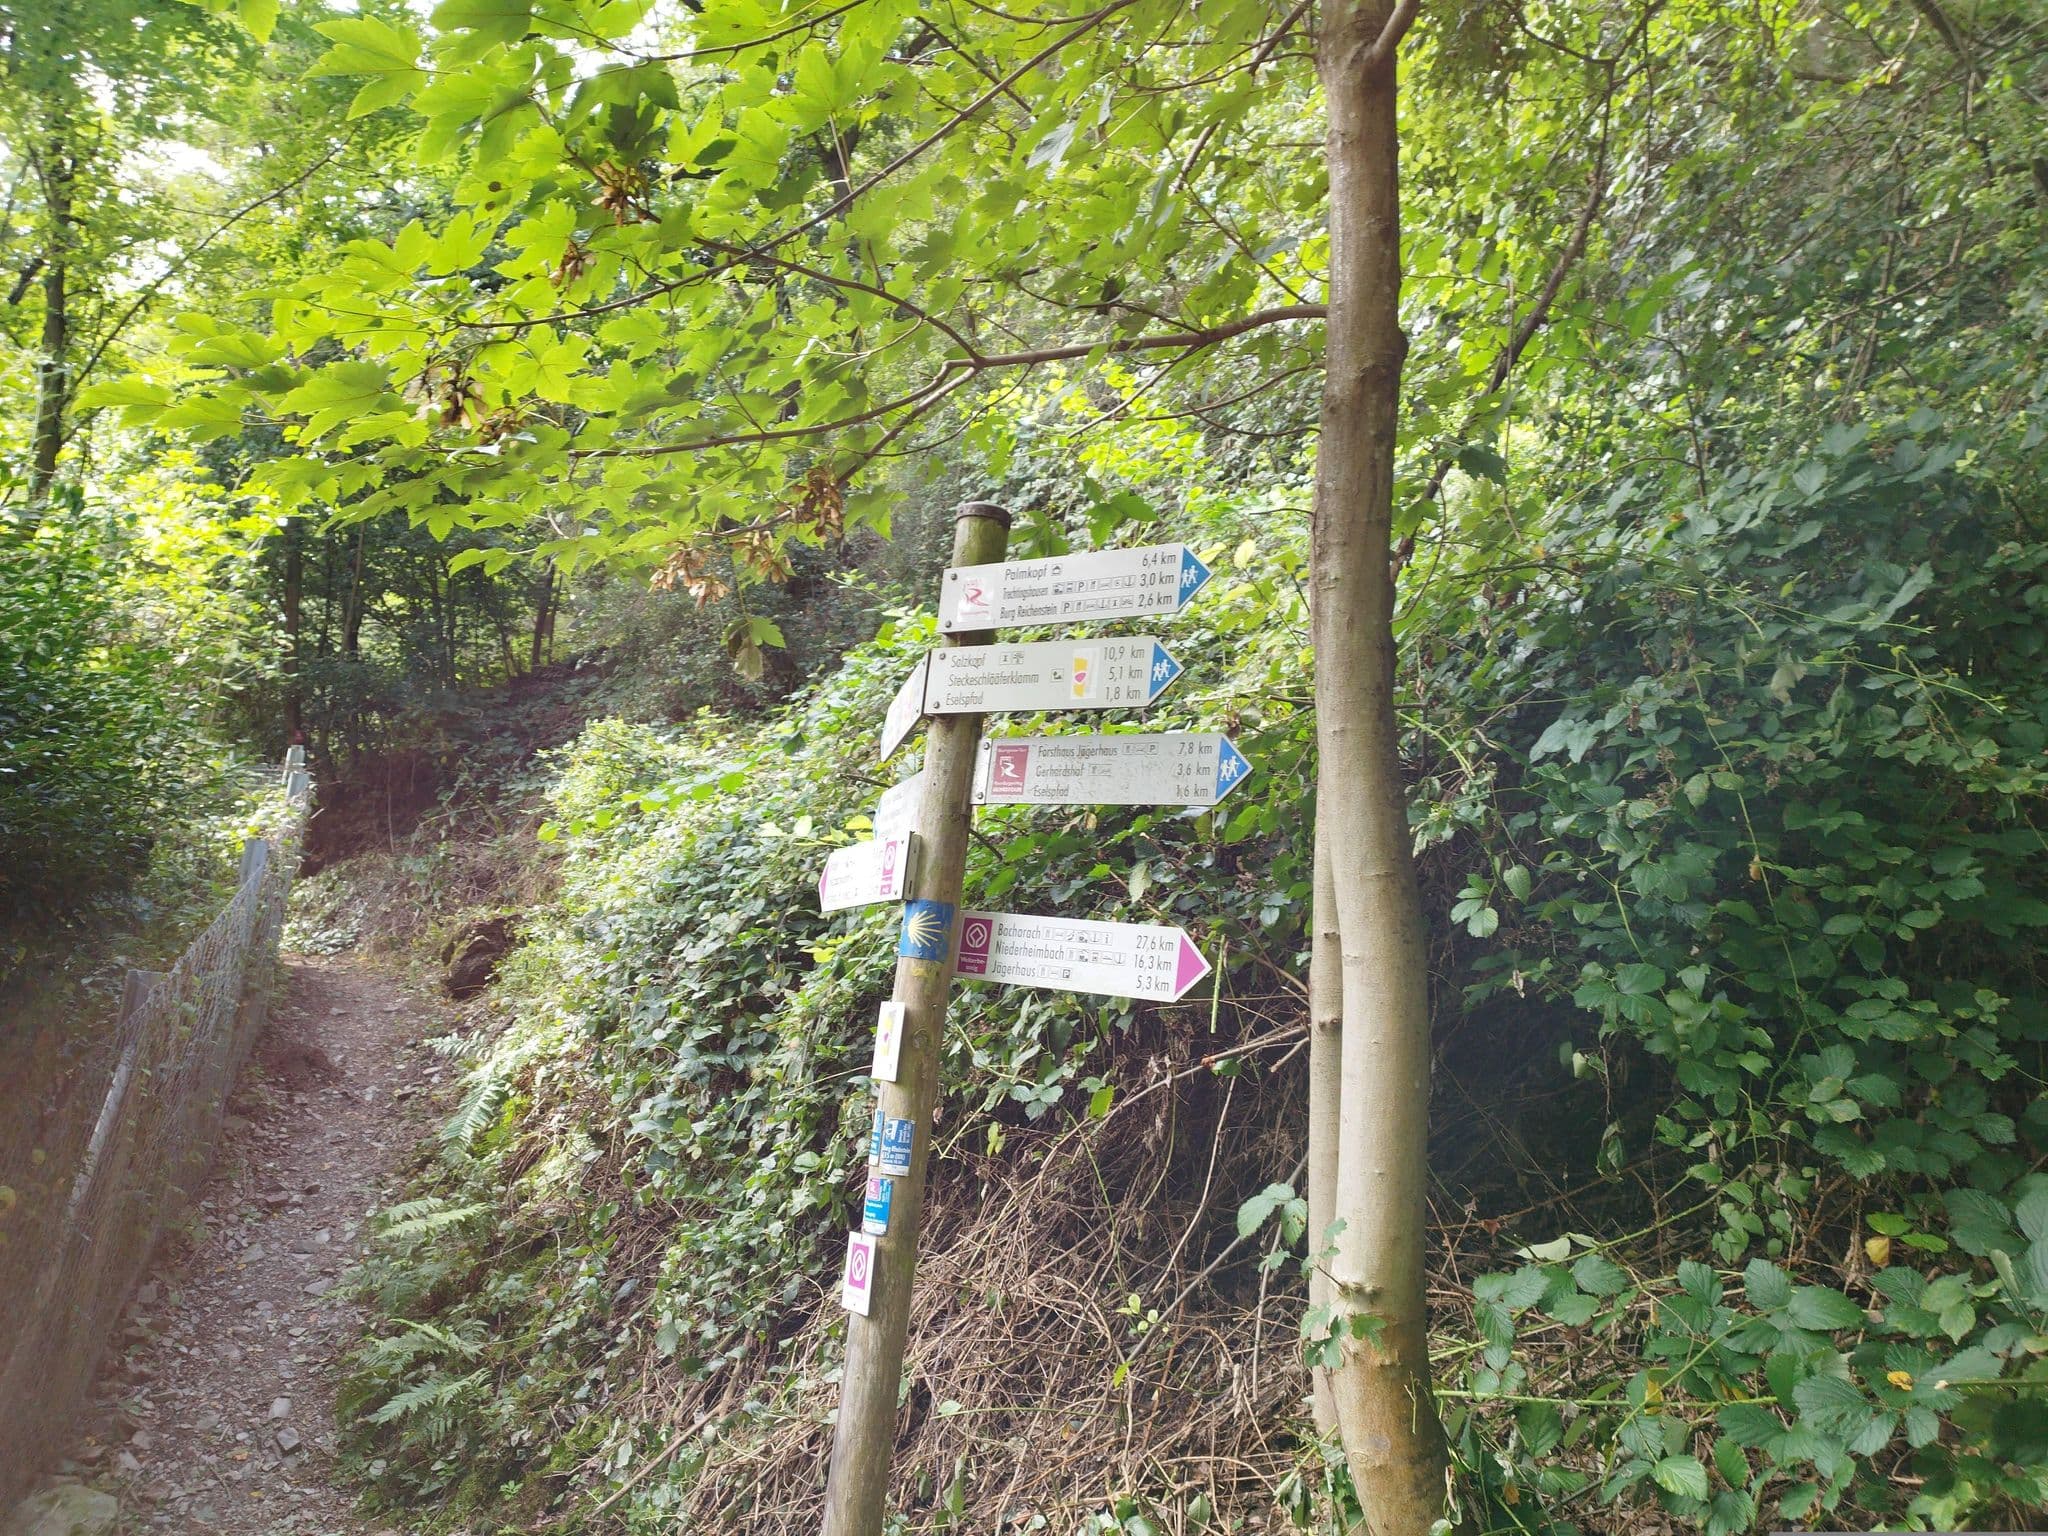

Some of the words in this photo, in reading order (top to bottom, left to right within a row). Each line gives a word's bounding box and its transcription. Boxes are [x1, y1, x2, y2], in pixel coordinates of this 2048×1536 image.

[1005, 564, 1047, 580] Palmkopf
[1142, 553, 1158, 568] 6,4
[1161, 552, 1176, 564] km
[1140, 573, 1156, 588] 3,0
[1159, 572, 1174, 584] km
[1138, 593, 1154, 608] 2,6
[1157, 592, 1172, 605] km
[951, 653, 986, 668] Salzkopf
[1104, 646, 1125, 662] 10,9
[1131, 646, 1144, 659] km
[1108, 666, 1123, 682] 5,1
[1128, 665, 1143, 679] km
[946, 691, 984, 707] Eselspfad
[1106, 686, 1121, 702] 1,8
[1126, 686, 1140, 699] km
[1038, 745, 1075, 758] Forsthaus
[1178, 742, 1194, 756] 7,8
[1198, 742, 1213, 755] km
[1036, 763, 1085, 778] Gerhardshof
[1177, 763, 1192, 778] 3,6
[1196, 763, 1210, 776] km
[1033, 784, 1070, 799] Eselspfad
[1176, 784, 1190, 799] 1,6
[1194, 783, 1208, 797] km
[998, 923, 1041, 939] Bacharach
[1136, 935, 1156, 952] 27,6
[1160, 936, 1174, 951] km
[995, 940, 1064, 960] Niederheimbach
[1135, 954, 1155, 971] 16,3
[1156, 955, 1172, 971] km
[992, 960, 1036, 977] Jägerhaus
[1136, 975, 1152, 992] 5,3
[1154, 977, 1169, 992] km
